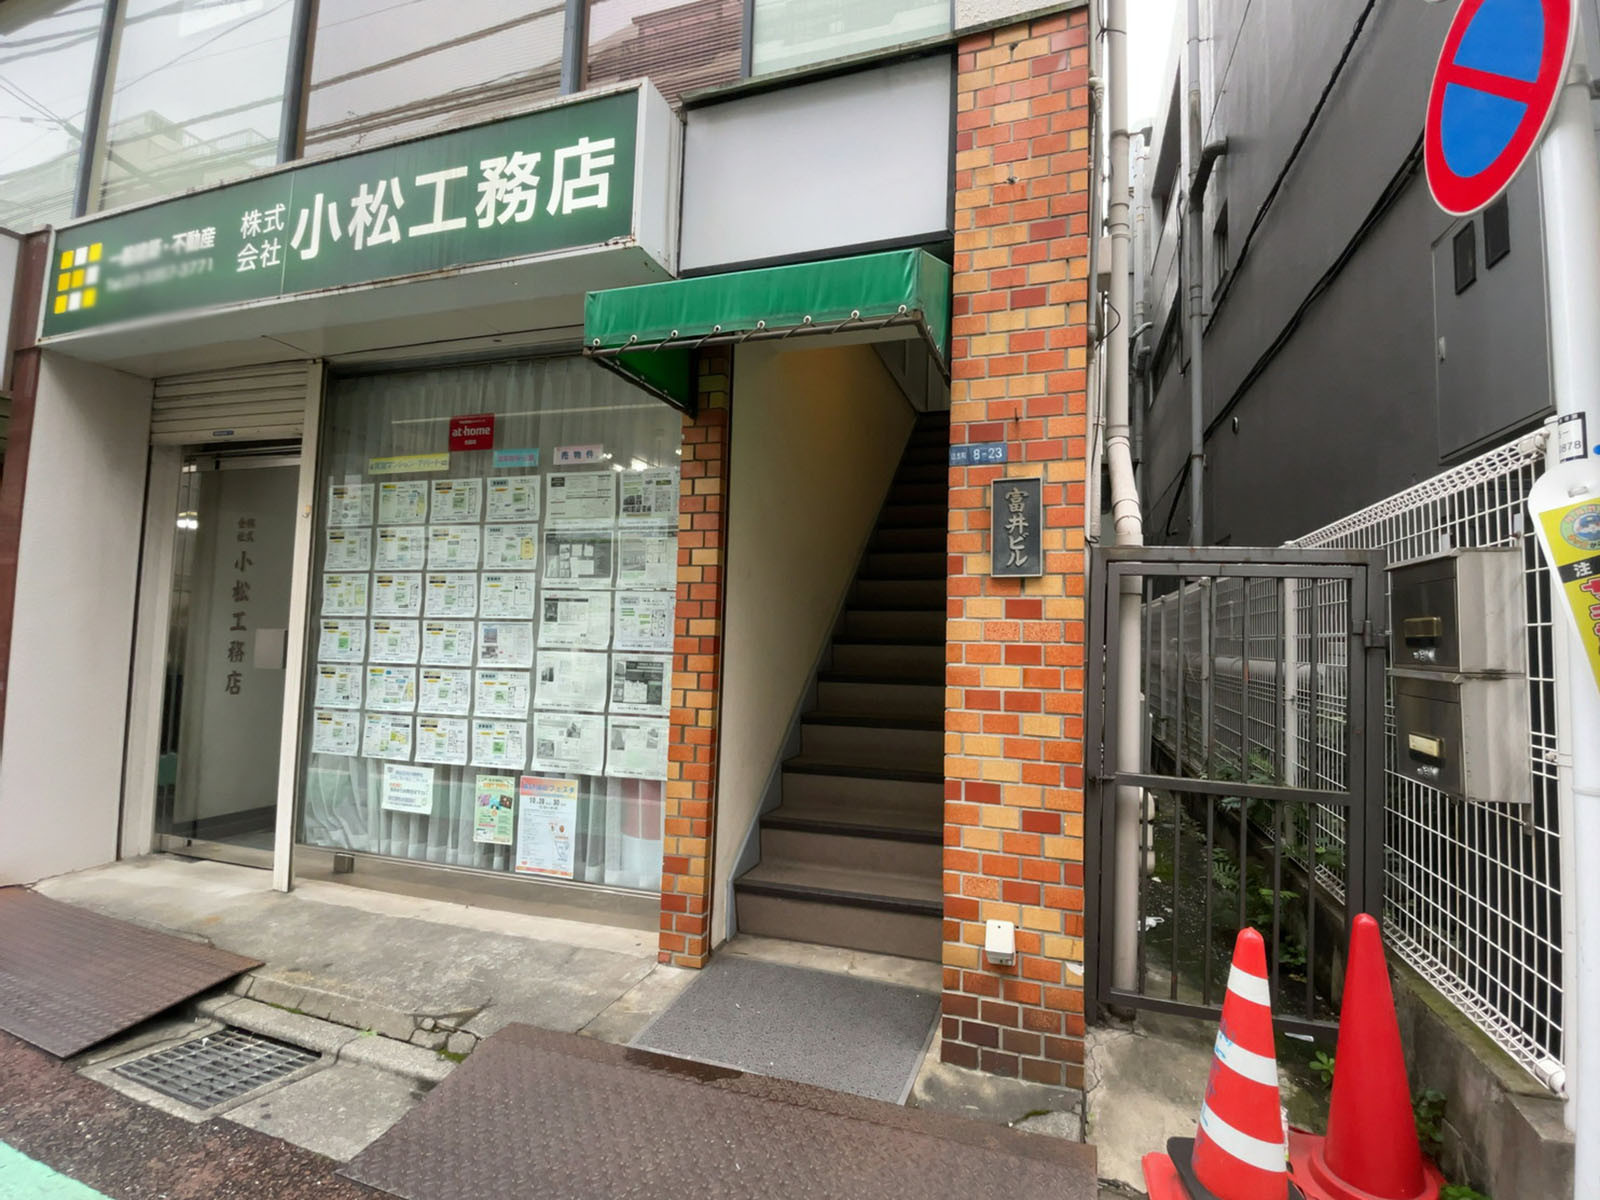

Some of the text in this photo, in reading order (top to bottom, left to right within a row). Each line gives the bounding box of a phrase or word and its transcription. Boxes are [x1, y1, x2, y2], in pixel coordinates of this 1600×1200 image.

[290, 136, 616, 261] 小松工務店
[240, 203, 286, 239] 株式
[236, 237, 282, 272] 会社
[973, 447, 1003, 461] 8-23
[1005, 487, 1029, 567] 富井ビル
[1573, 561, 1593, 578] 注
[225, 550, 254, 695] 小松工務店
